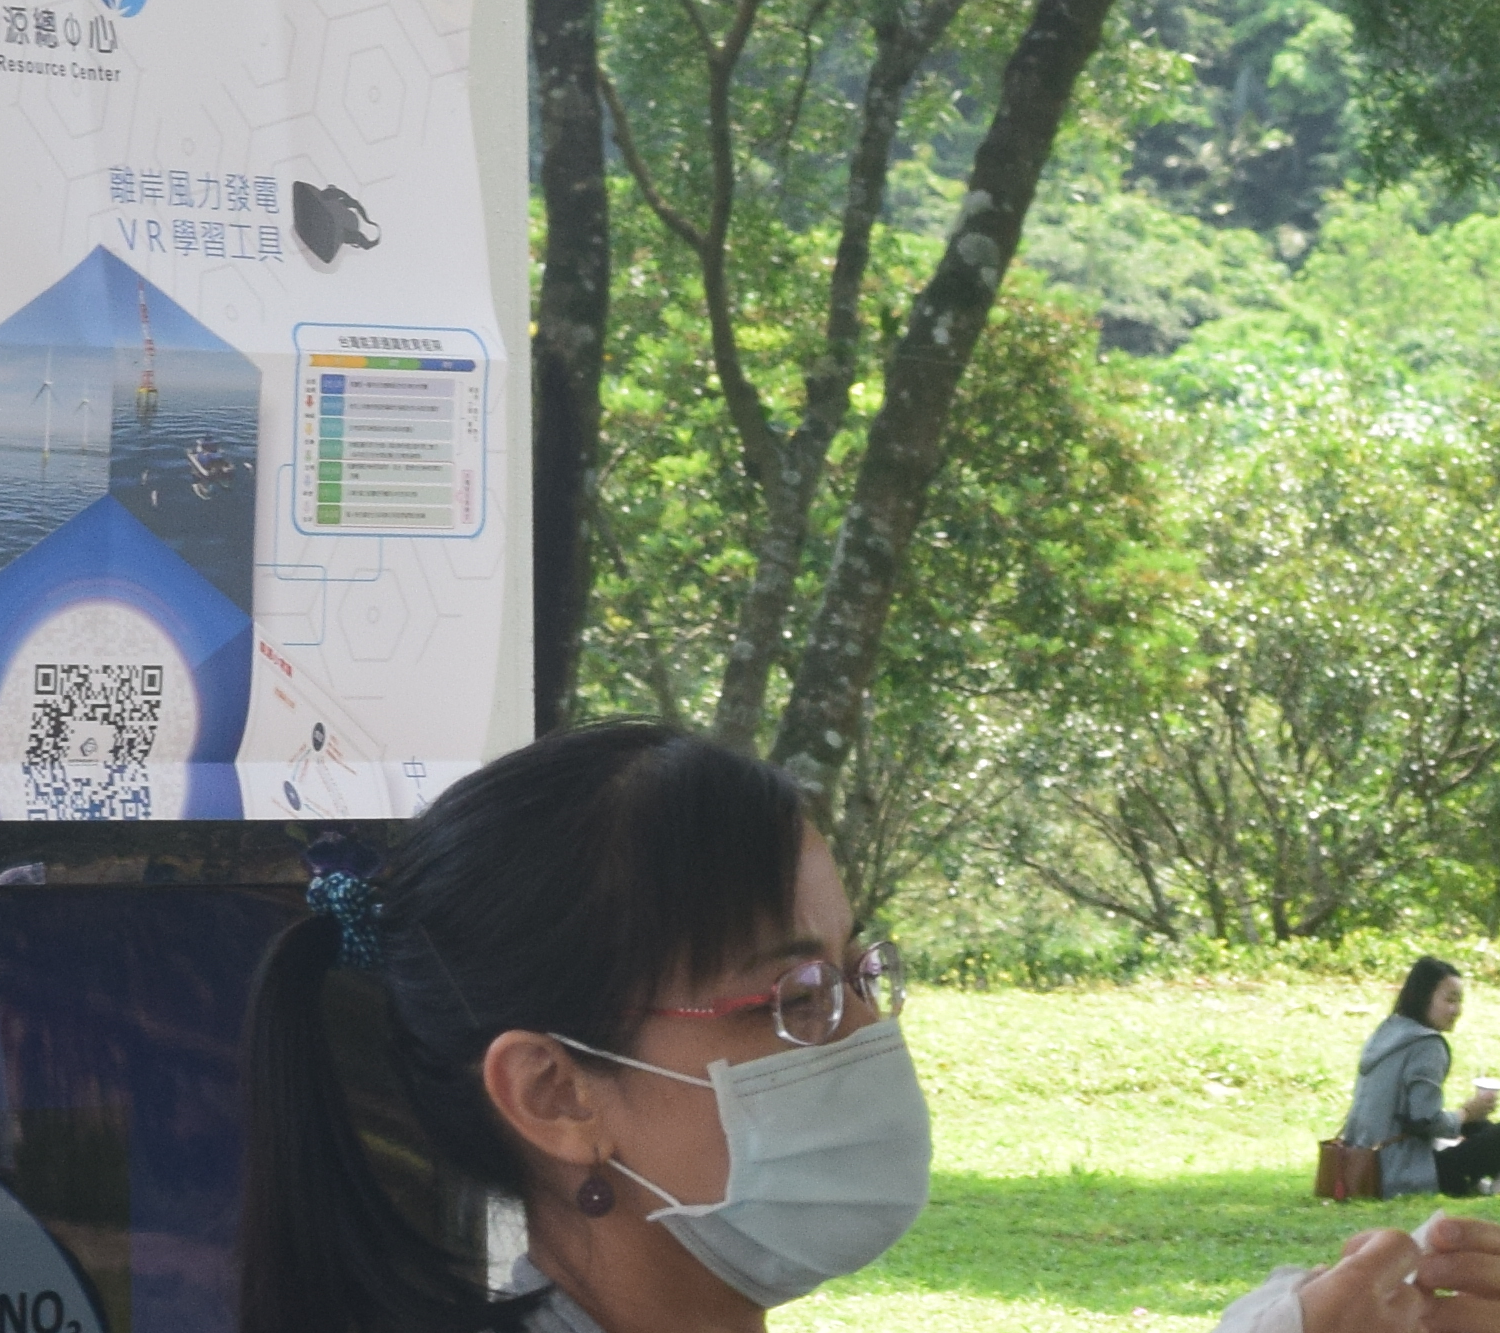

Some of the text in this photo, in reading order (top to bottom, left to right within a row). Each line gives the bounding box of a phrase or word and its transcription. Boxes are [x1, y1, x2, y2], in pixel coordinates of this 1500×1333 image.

[71, 62, 121, 83] Center
[109, 166, 280, 215] 離岸風力發電
